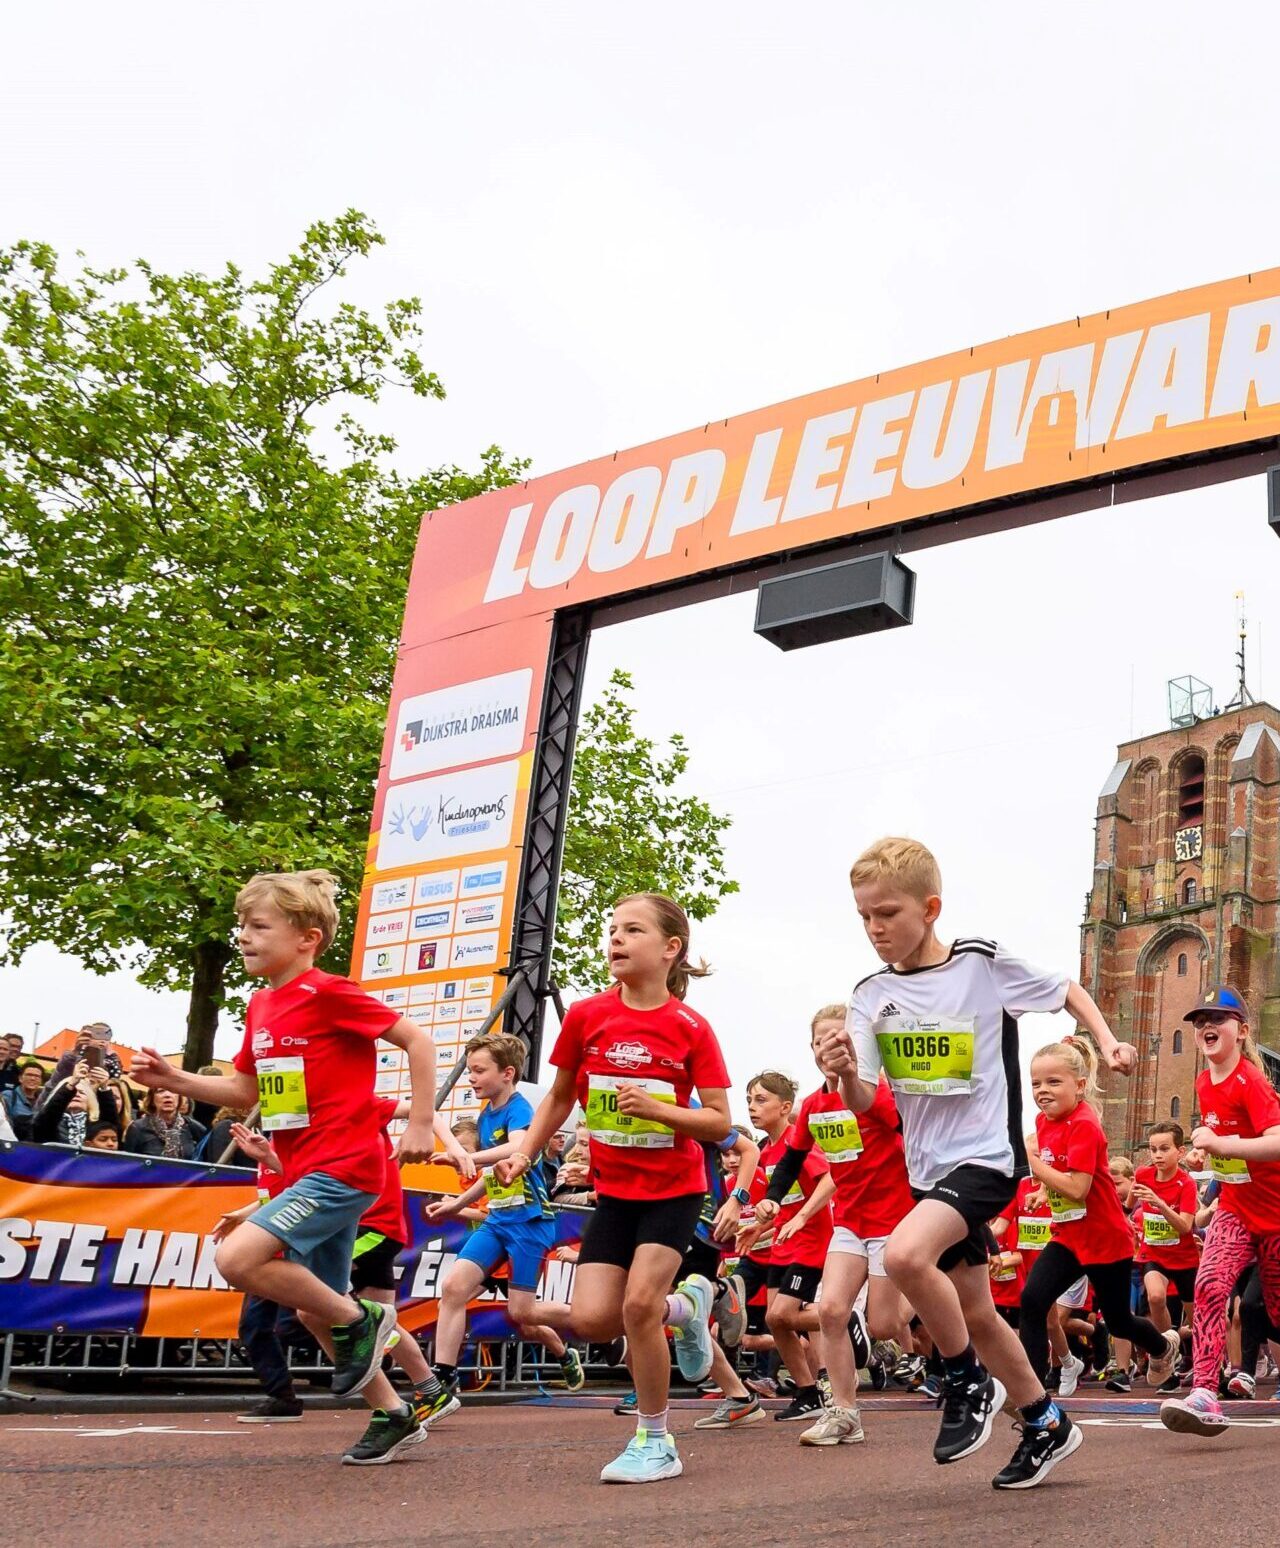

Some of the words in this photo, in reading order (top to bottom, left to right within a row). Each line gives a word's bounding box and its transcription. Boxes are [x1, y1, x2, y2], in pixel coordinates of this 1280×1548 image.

[483, 447, 726, 604] LOOP
[423, 718, 468, 743] DIJKSTRA
[471, 706, 519, 732] DRAISMA
[421, 882, 453, 897] URSUS
[892, 1036, 950, 1057] 10366
[911, 1061, 931, 1071] HUGO
[260, 1075, 284, 1095] 410
[600, 1093, 618, 1113] 10
[616, 1116, 633, 1126] LISE
[816, 1123, 845, 1140] 0720
[1023, 1224, 1046, 1235] 10587
[1147, 1220, 1171, 1231] 10205
[0, 1218, 107, 1283] STE
[112, 1228, 229, 1290] HAR
[790, 1275, 802, 1290] 10
